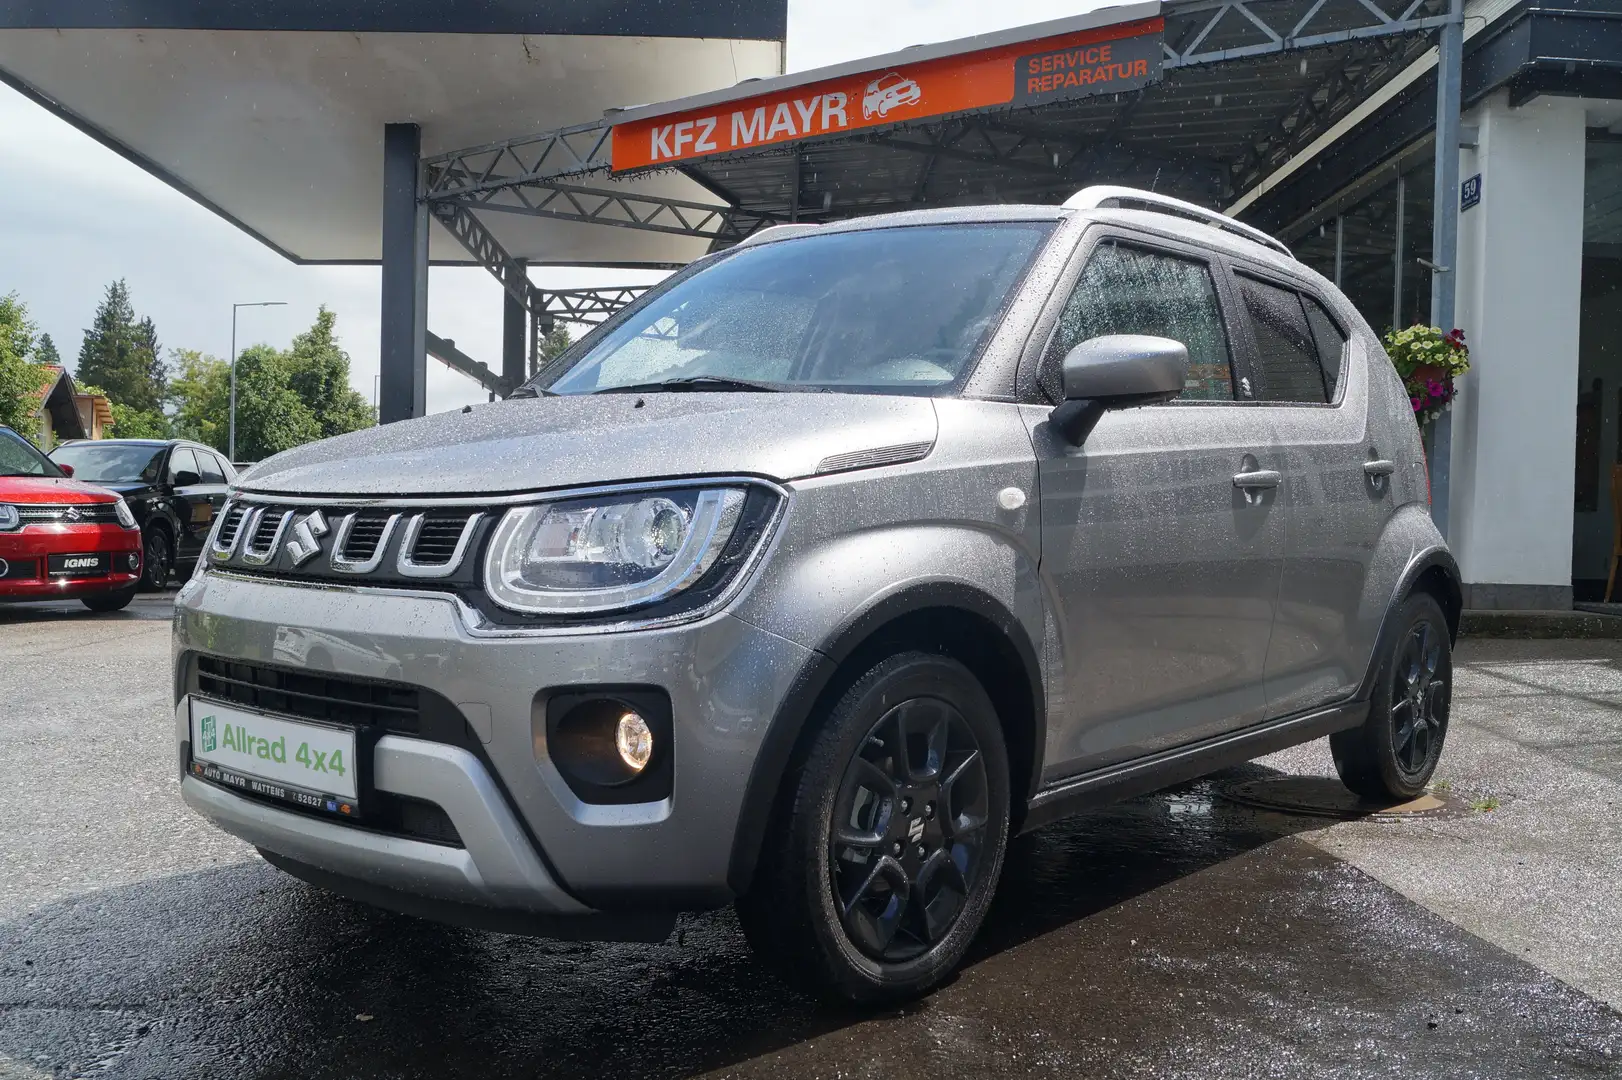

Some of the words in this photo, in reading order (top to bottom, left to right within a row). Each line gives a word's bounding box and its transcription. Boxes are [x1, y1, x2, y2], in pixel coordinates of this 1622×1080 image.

[1028, 59, 1148, 93] REPARATUR
[1029, 45, 1112, 74] SERVICE
[650, 115, 717, 160] KFZ
[731, 91, 848, 144] MAYR
[1465, 179, 1477, 199] 59
[64, 558, 99, 568] IGNIS
[222, 723, 287, 764] Allrad
[295, 742, 346, 777] 4x4
[203, 767, 221, 780] AUTO
[223, 772, 246, 787] MAYR
[251, 781, 285, 798] WATTENS
[297, 793, 322, 807] 52627
